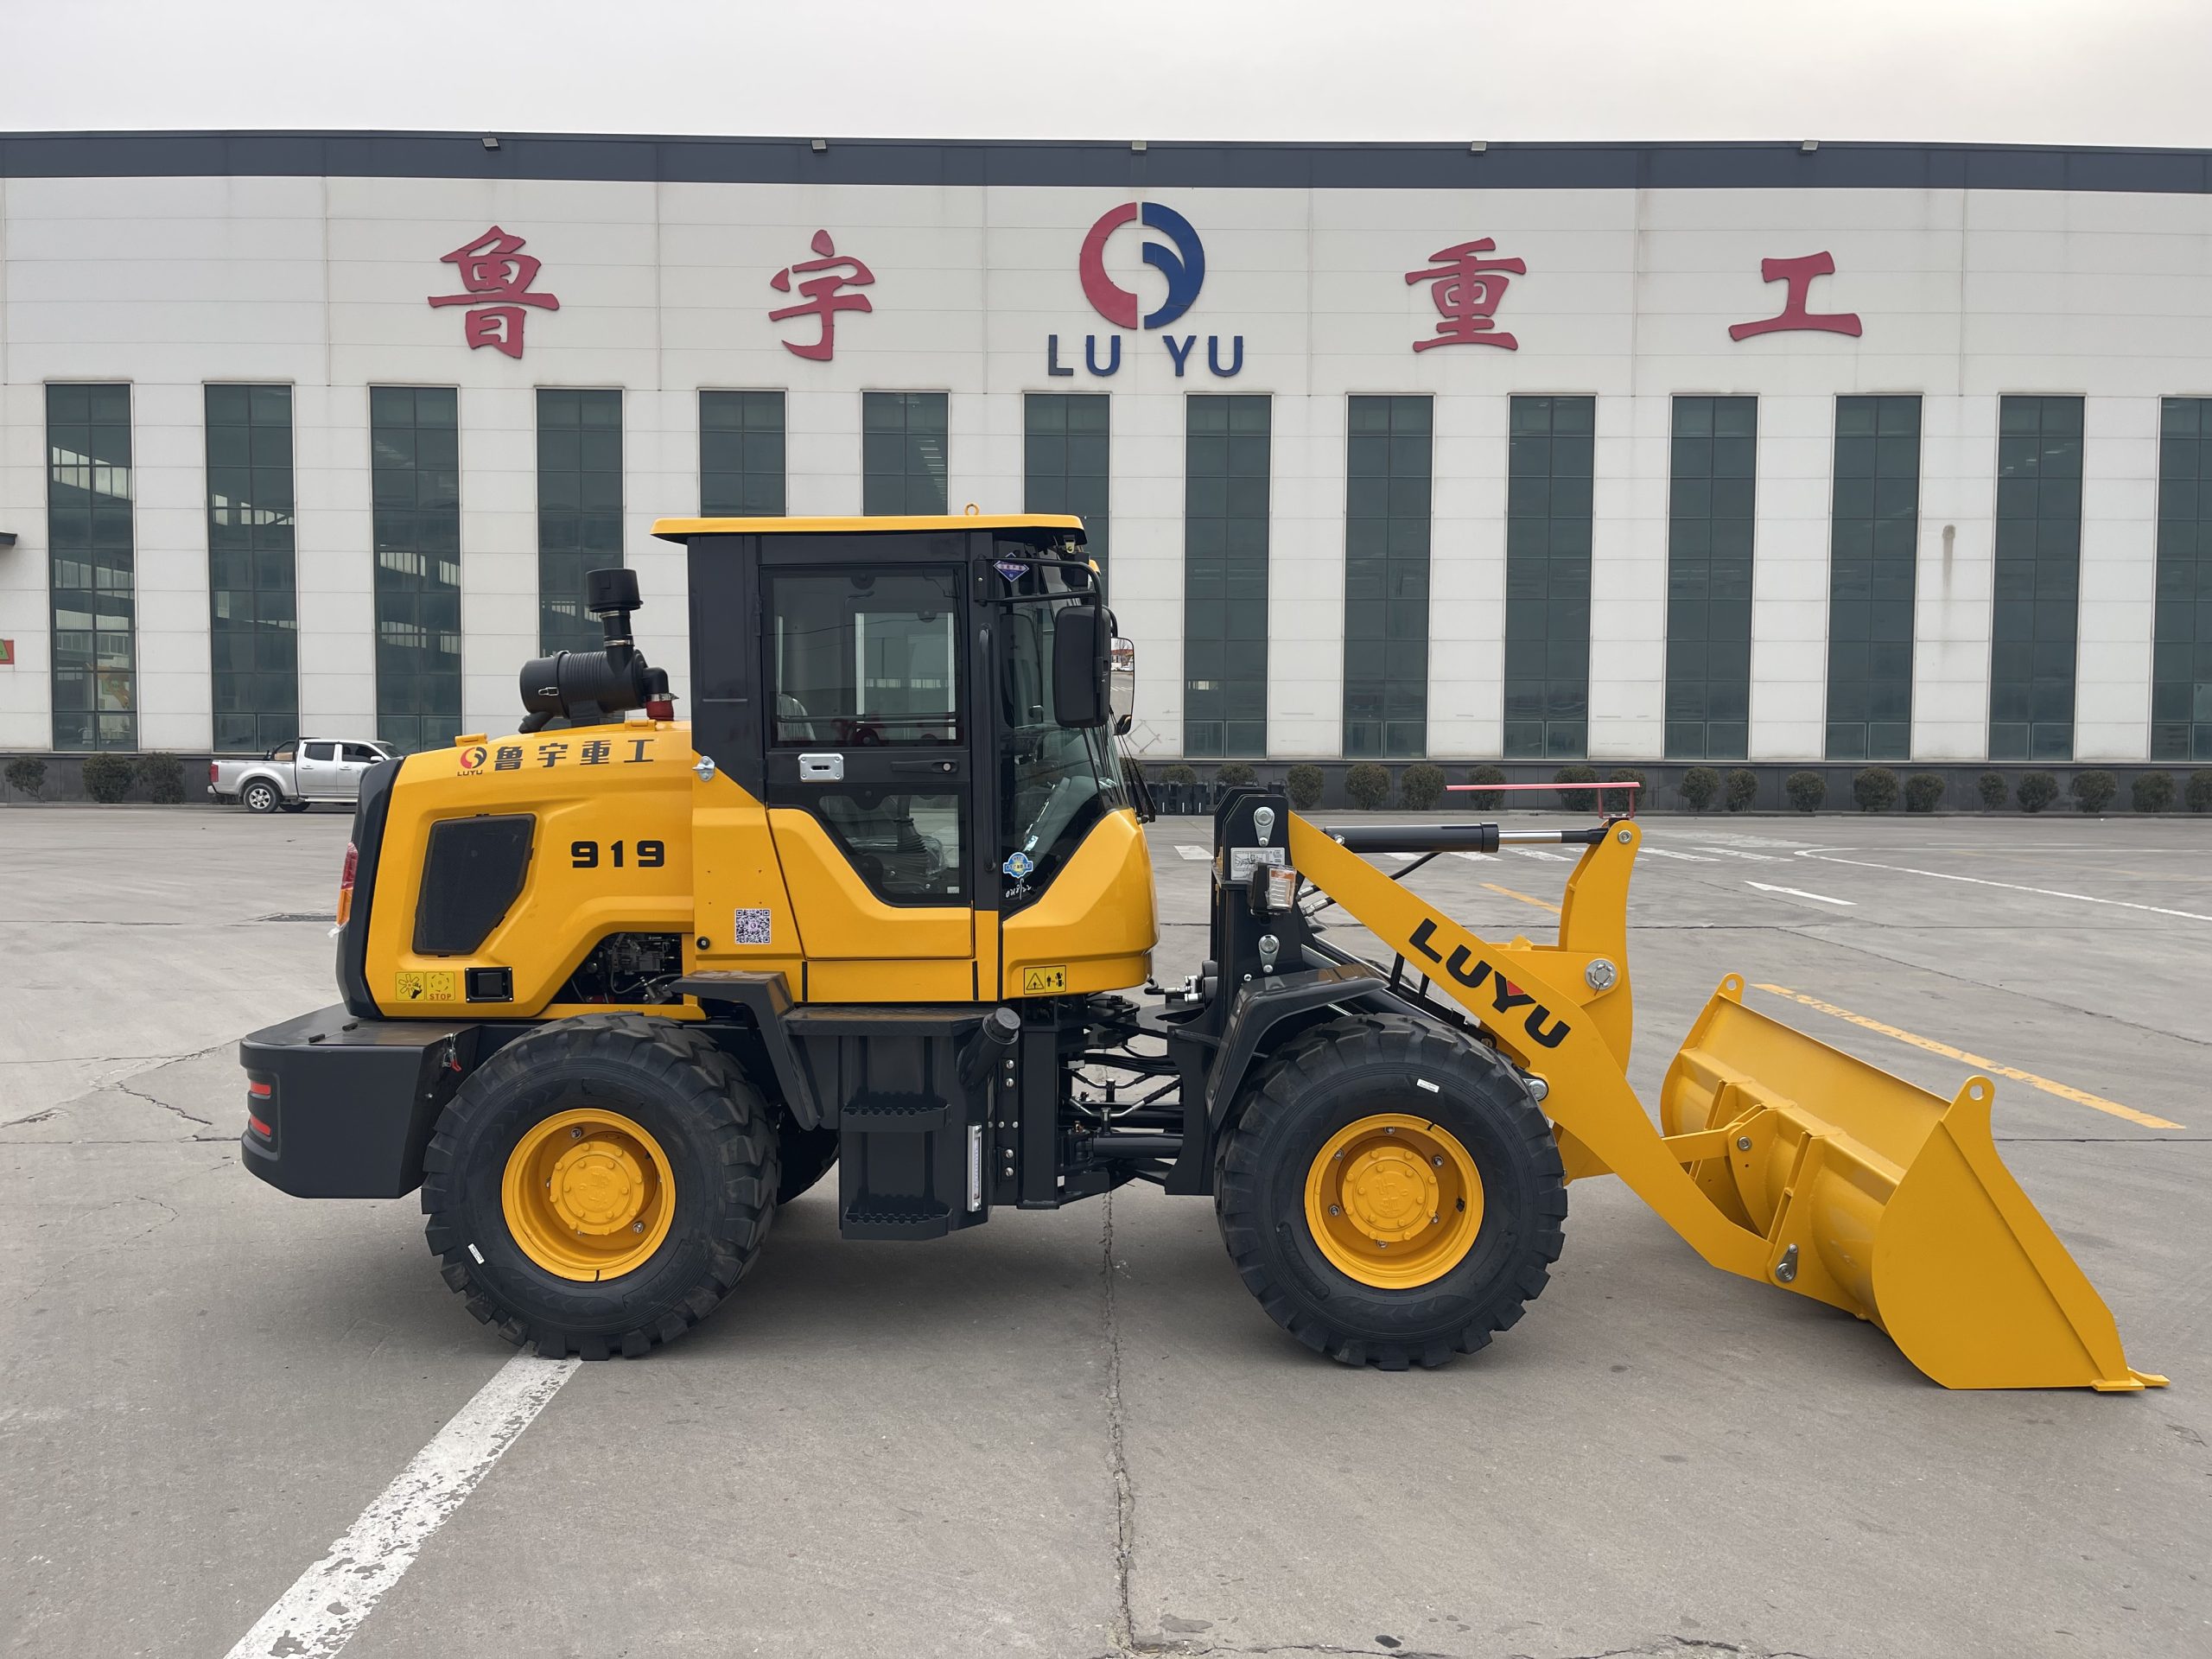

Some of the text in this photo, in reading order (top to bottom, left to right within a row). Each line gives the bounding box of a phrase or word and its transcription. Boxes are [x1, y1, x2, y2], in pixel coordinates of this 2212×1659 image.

[494, 739, 654, 771] 鲁宇重工
[570, 840, 665, 868] 919
[1408, 918, 1571, 1048] LUYU
